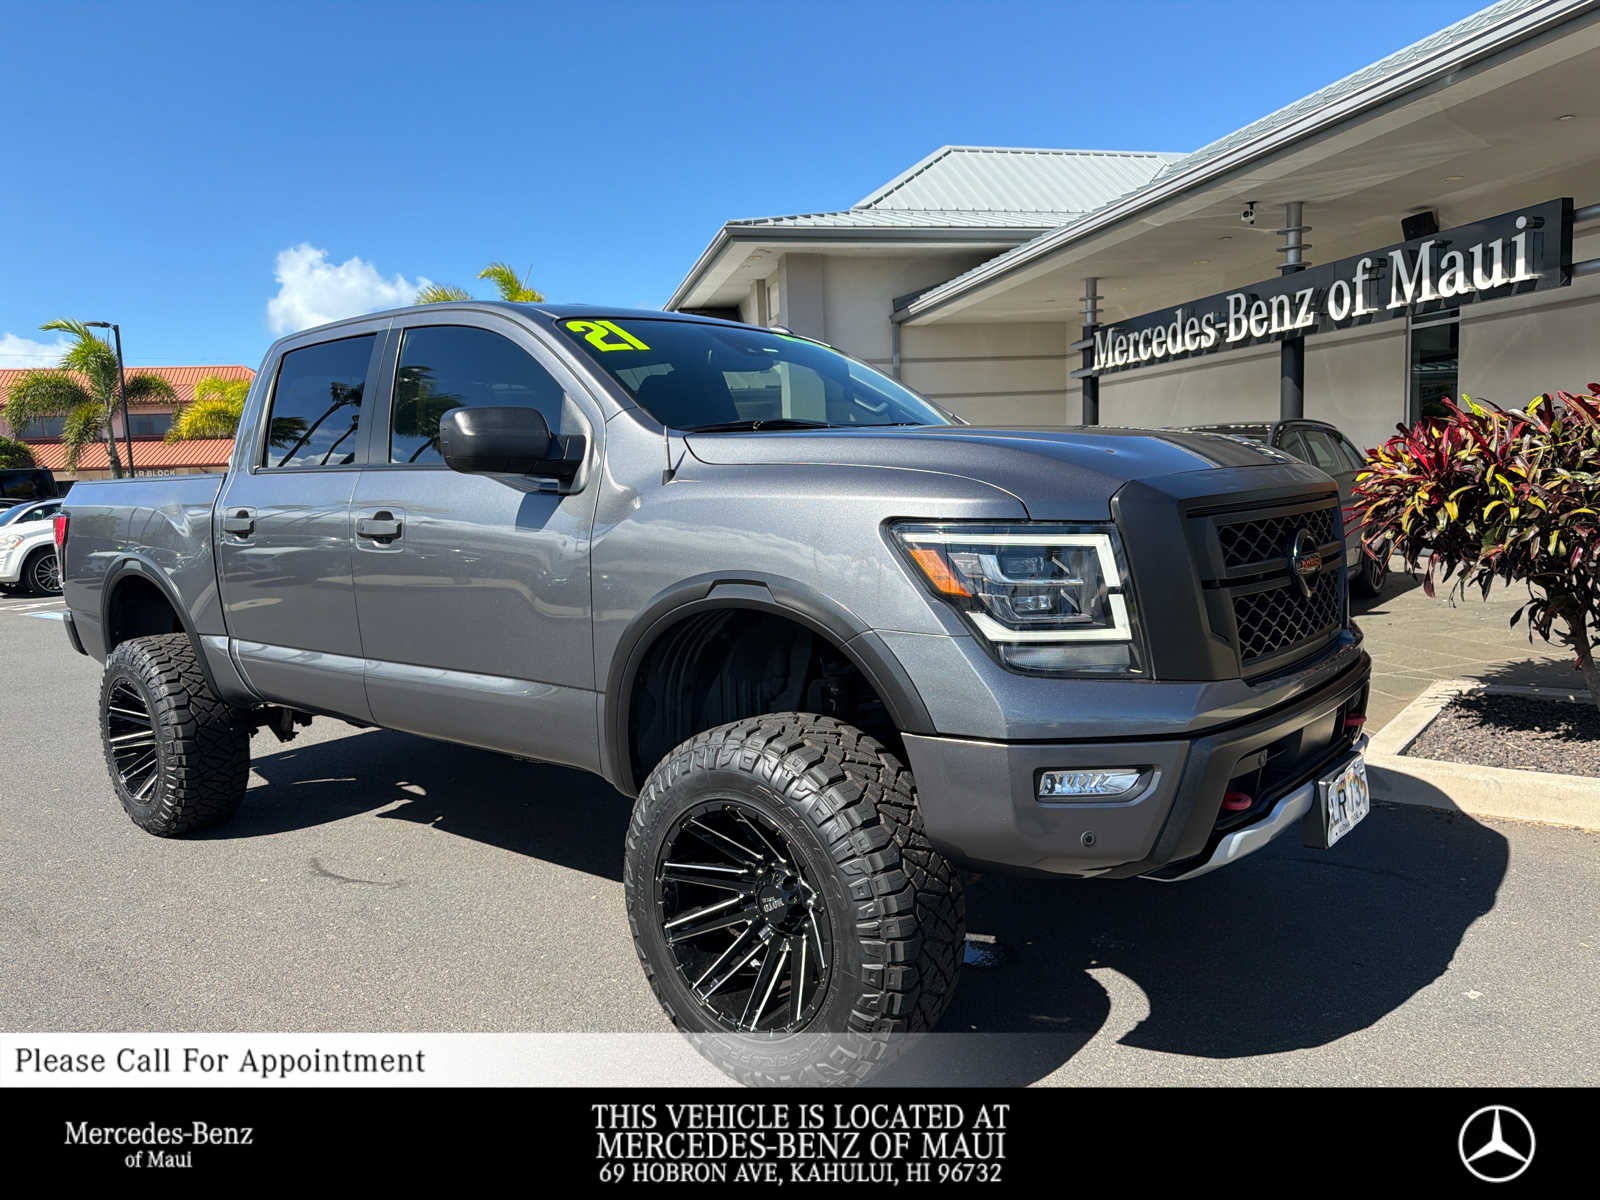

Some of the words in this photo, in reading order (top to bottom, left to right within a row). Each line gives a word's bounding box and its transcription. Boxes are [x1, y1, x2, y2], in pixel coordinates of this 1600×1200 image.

[566, 320, 651, 352] 21
[1092, 286, 1315, 371] Mercedes-Benz
[1327, 257, 1379, 321] of
[1386, 216, 1543, 310] Maui
